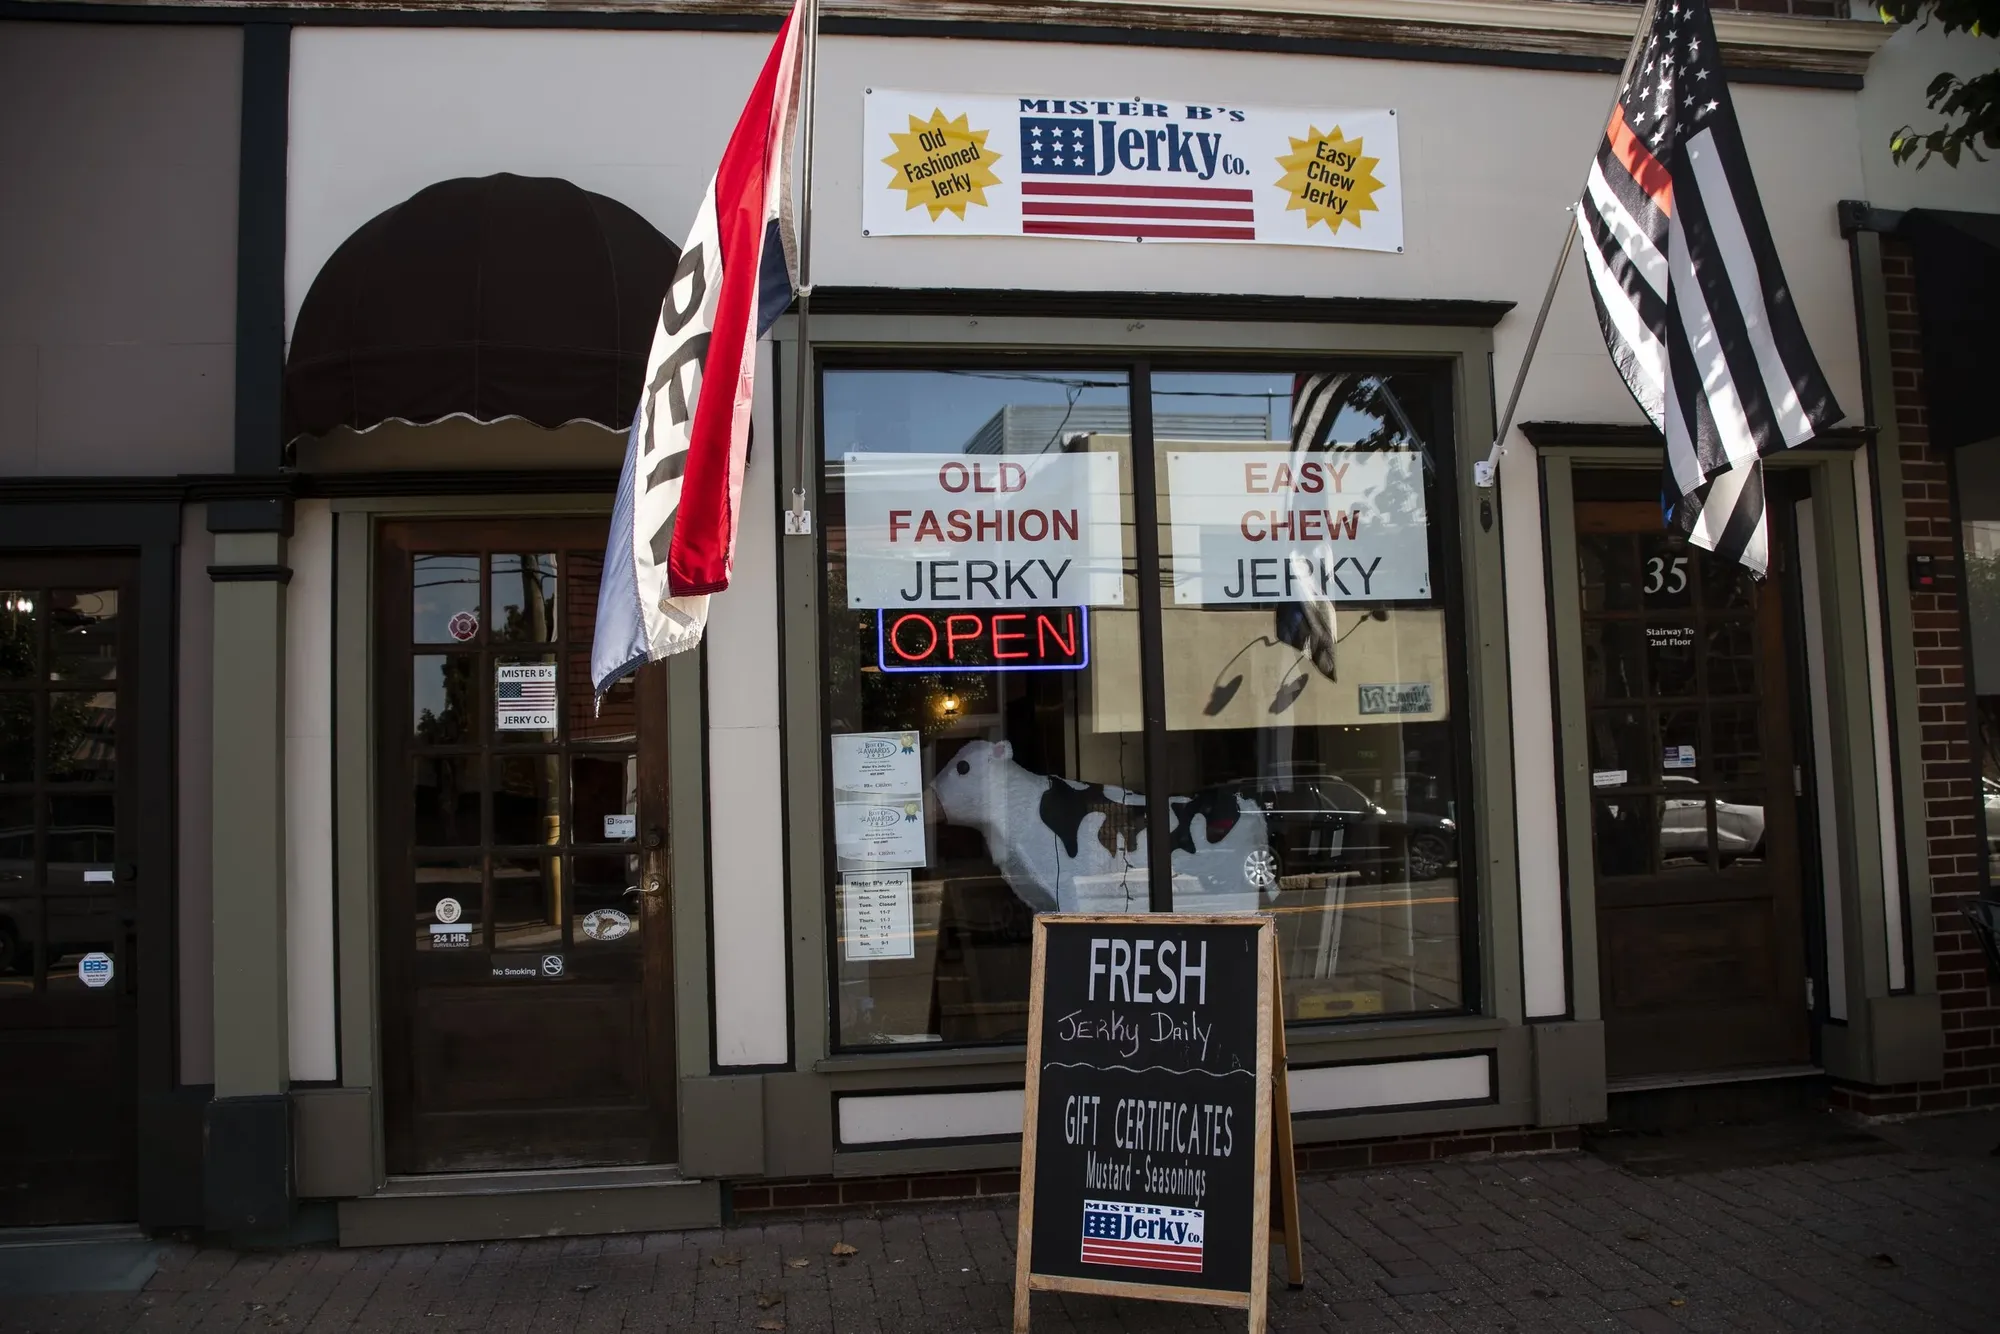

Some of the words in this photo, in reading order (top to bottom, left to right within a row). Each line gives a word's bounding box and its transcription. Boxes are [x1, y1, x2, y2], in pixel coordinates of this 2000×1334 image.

[1019, 98, 1169, 118] MISTER
[1185, 105, 1246, 122] B'S
[918, 127, 948, 152] Old
[1097, 120, 1222, 181] Jerky
[1222, 153, 1251, 176] Co.
[1315, 140, 1357, 170] Easy
[902, 142, 980, 184] Fashioned
[1306, 160, 1356, 192] Chew
[930, 172, 973, 201] Jerky
[1300, 181, 1348, 216] Jerky
[938, 461, 1027, 494] OLD
[1244, 462, 1350, 494] EASY
[888, 508, 1079, 543] FASHION
[1240, 510, 1360, 542] CHEW
[900, 558, 1073, 602] JERKY
[1223, 556, 1383, 599] JERKY
[1643, 555, 1689, 594] 35
[890, 613, 1076, 662] OPEN
[1646, 627, 1682, 637] Stairway
[1682, 627, 1695, 636] To
[1650, 638, 1667, 646] 2nd
[1668, 637, 1692, 646] Floor
[501, 669, 536, 678] MISTER
[538, 668, 552, 678] B's
[504, 715, 532, 725] JERKY
[533, 715, 550, 724] CO.
[585, 914, 594, 922] HI
[594, 909, 627, 921] MOUNTAIN
[433, 934, 448, 943] 24
[450, 933, 470, 943] HR.
[585, 927, 628, 940] SEAONINGS
[492, 967, 503, 976] No
[504, 966, 537, 978] Smoking
[1088, 938, 1207, 1005] FRESH
[1065, 1095, 1101, 1146] GIFT
[1114, 1098, 1234, 1158] CERTIFICATES
[1085, 1150, 1133, 1192] Mustard
[1144, 1154, 1207, 1207] Seasonings
[1085, 1202, 1162, 1215] MISTER
[1121, 1214, 1189, 1245] Jerky
[1187, 1232, 1203, 1244] Co.
